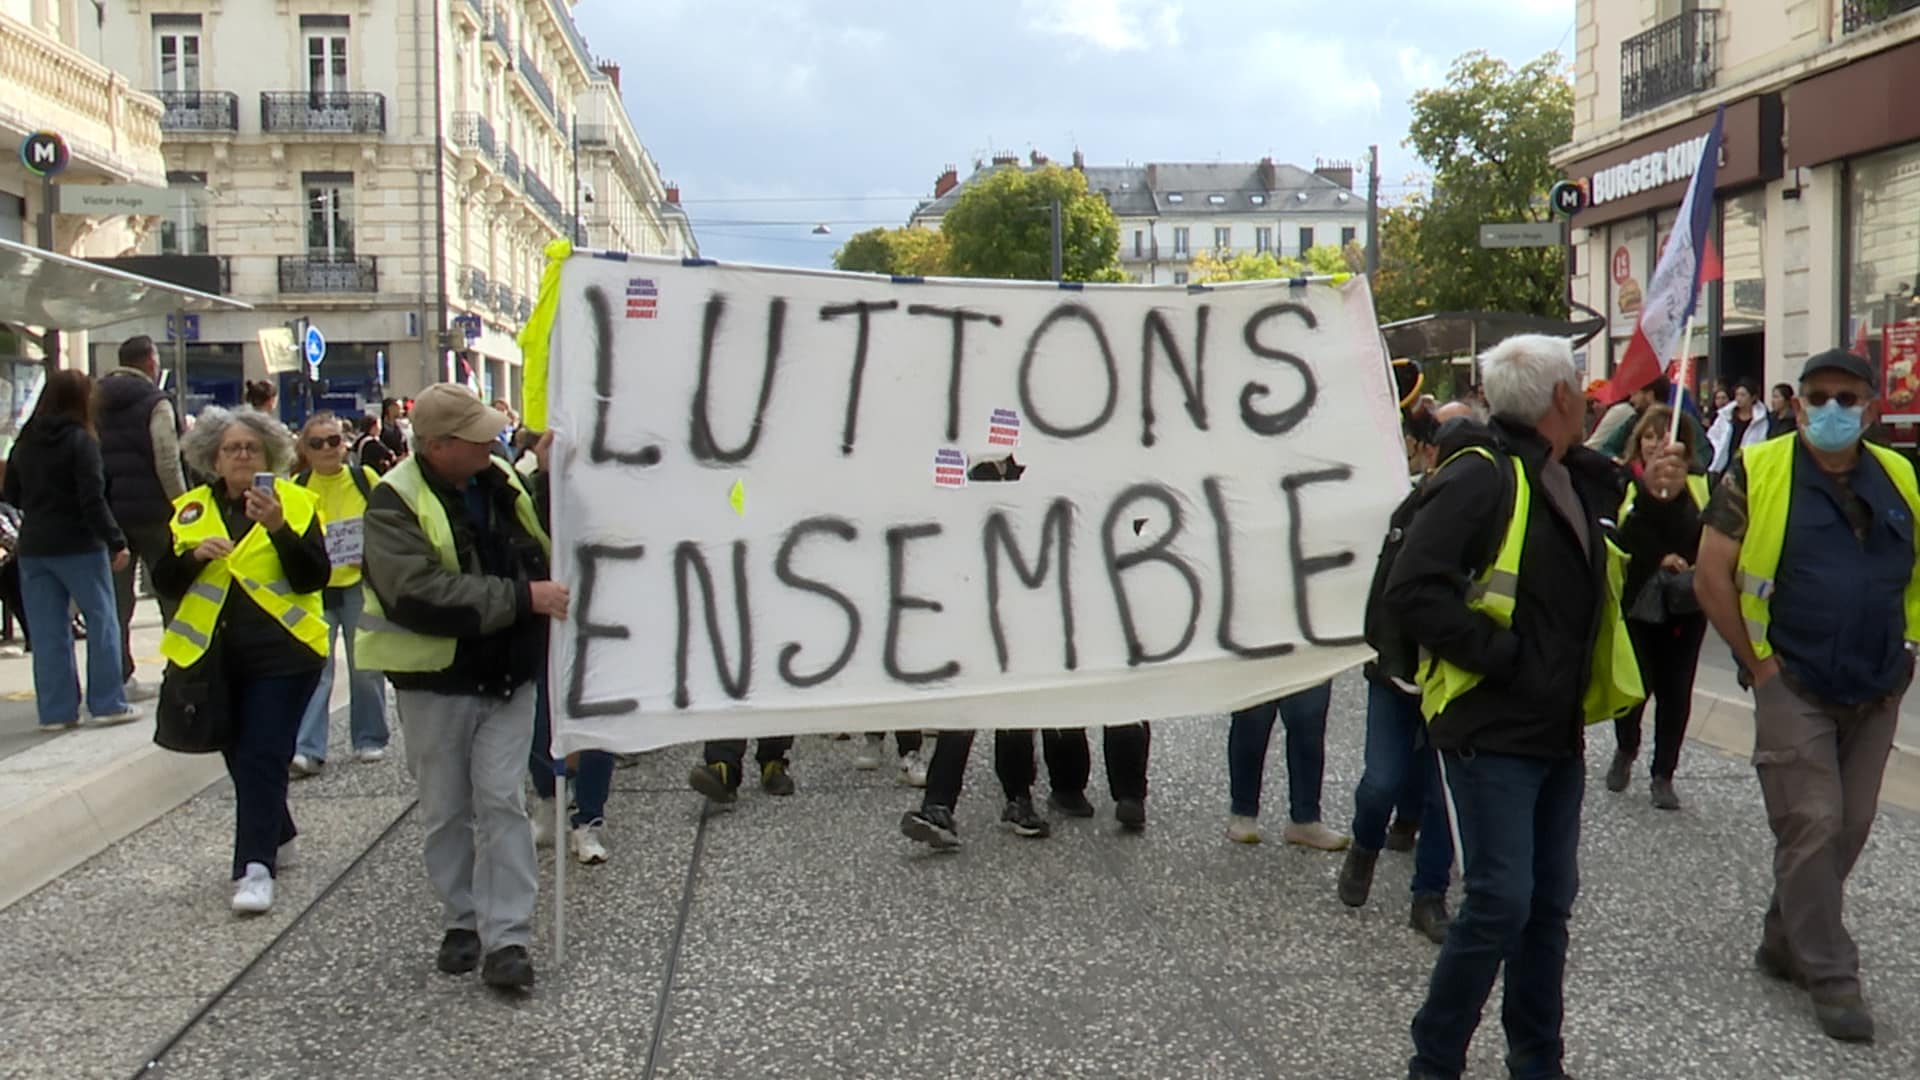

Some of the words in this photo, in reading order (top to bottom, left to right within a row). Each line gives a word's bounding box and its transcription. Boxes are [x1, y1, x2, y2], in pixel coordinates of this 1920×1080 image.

[34, 143, 55, 163] M
[1593, 151, 1665, 205] BURGER
[1666, 133, 1724, 181] KIN
[83, 195, 114, 205] Victor
[116, 195, 143, 207] Hugo
[1562, 193, 1578, 207] M
[584, 285, 1319, 467] LUTTONS
[566, 465, 1365, 719] ENSEMBLE
